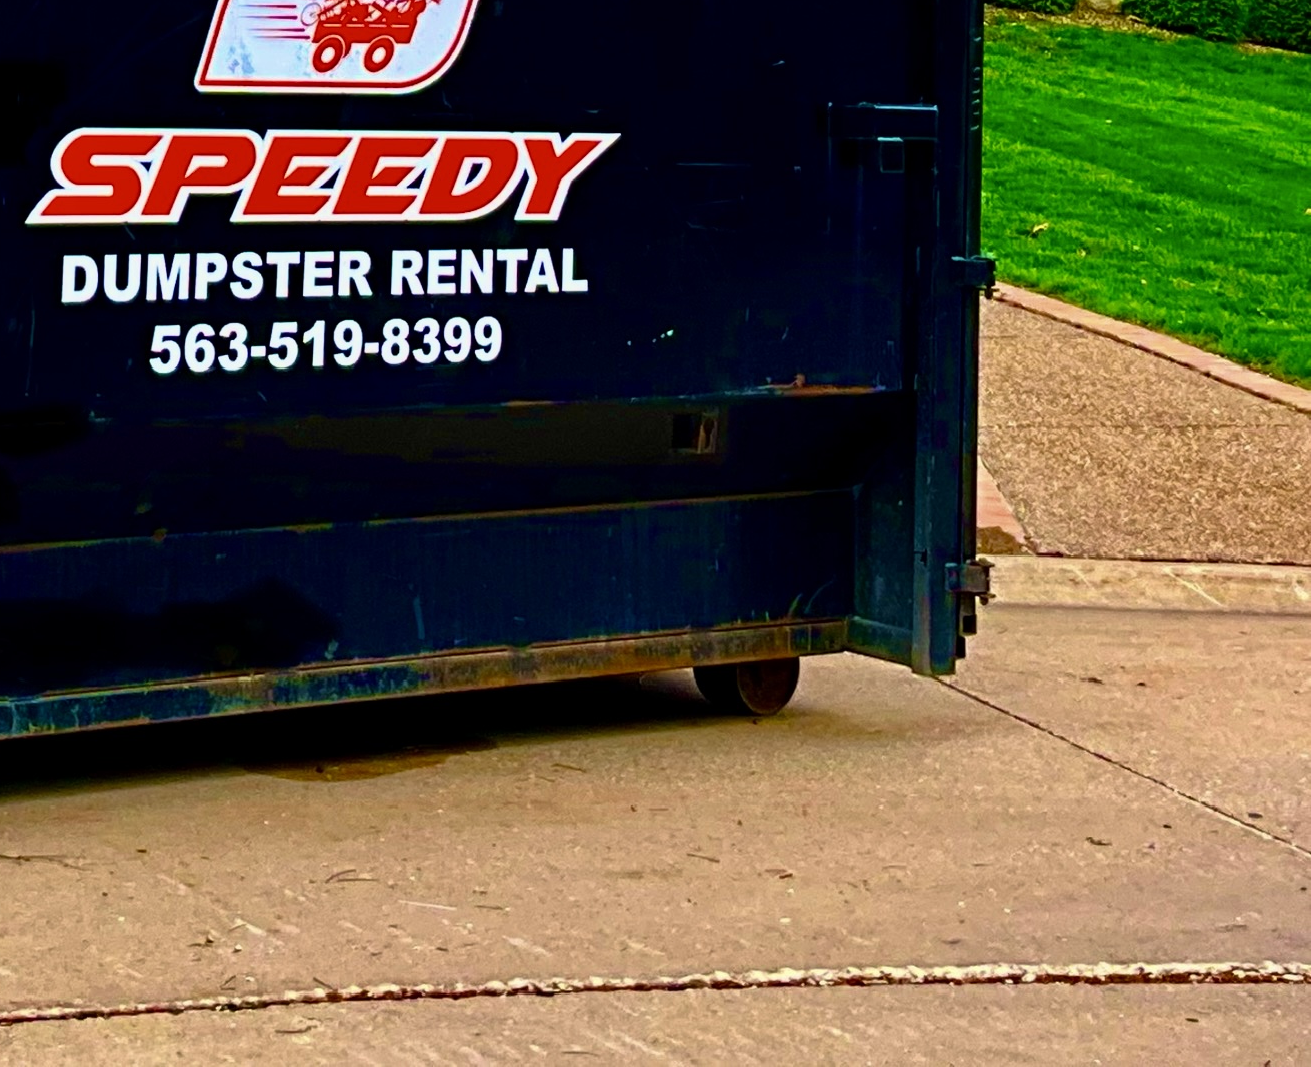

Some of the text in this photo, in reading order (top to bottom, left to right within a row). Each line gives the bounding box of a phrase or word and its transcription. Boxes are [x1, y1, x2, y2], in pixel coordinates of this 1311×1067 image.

[25, 127, 621, 224] SPEEDY
[61, 247, 589, 304] DUMPSTER RENTAL
[148, 316, 503, 375] 563-519-8399
